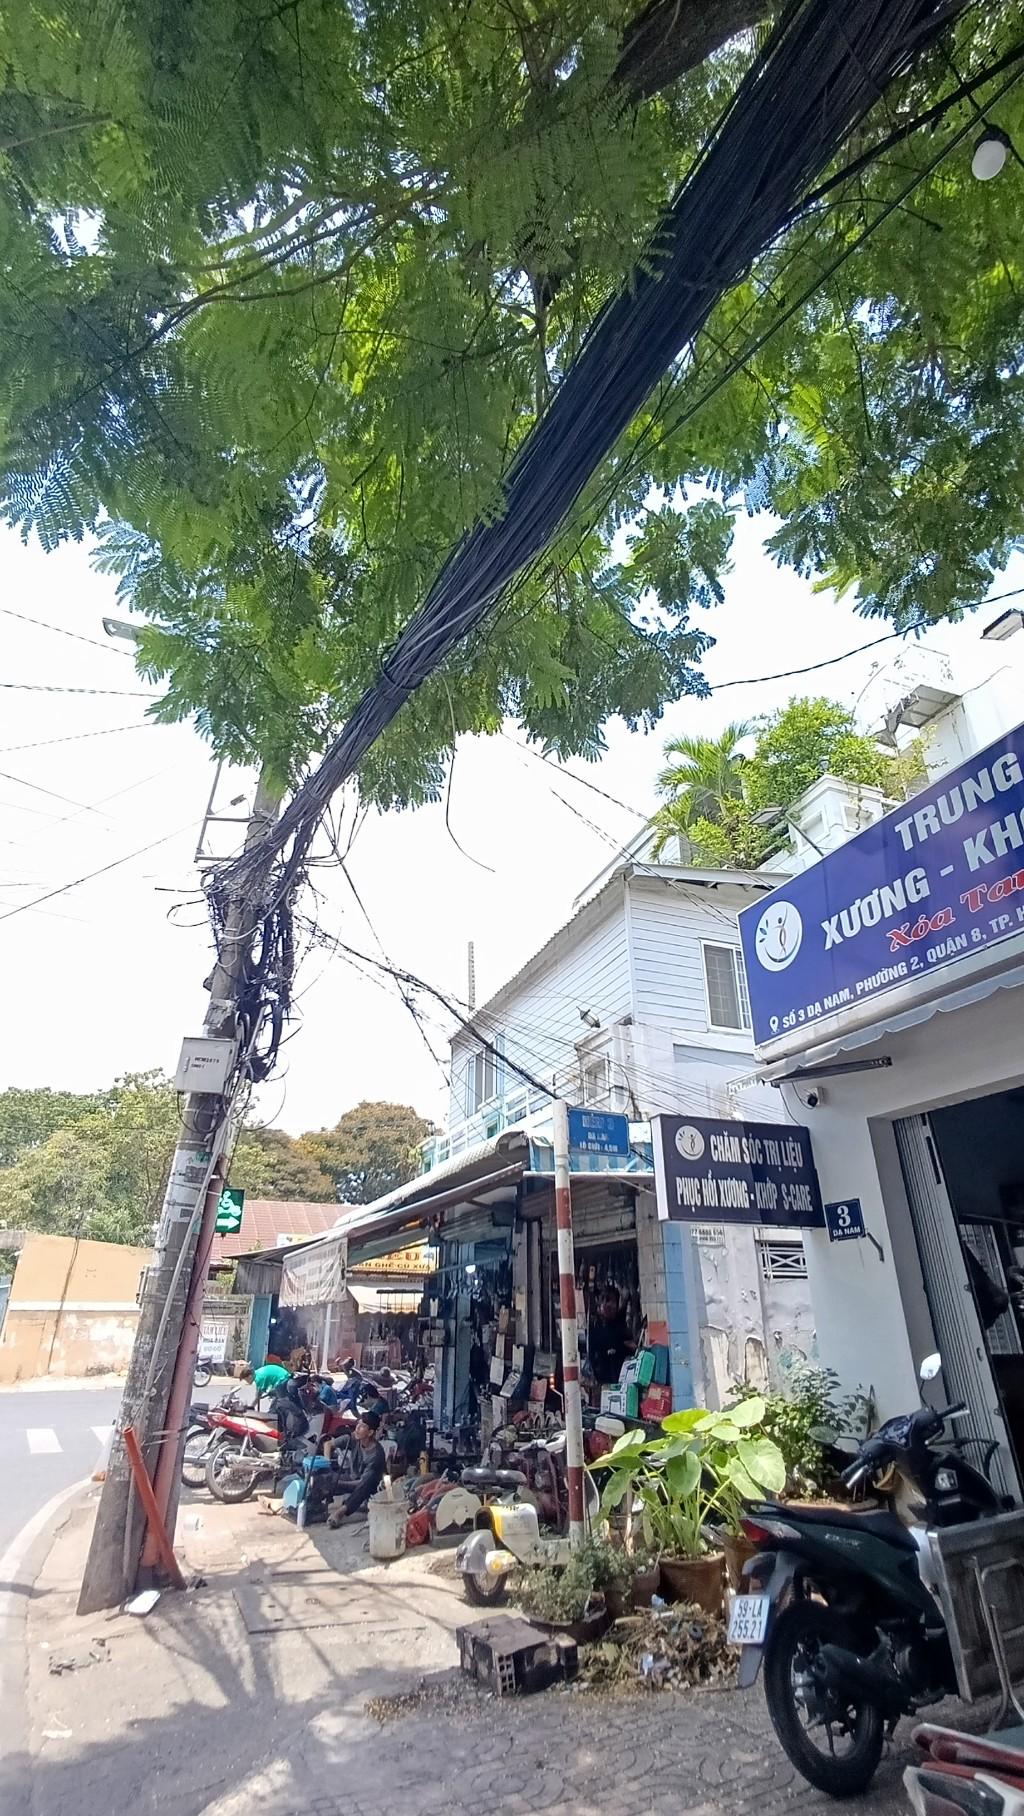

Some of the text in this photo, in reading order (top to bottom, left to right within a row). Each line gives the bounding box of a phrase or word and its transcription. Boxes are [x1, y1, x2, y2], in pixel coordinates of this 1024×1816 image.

[894, 752, 1024, 852] TRUNG
[820, 867, 931, 951] XƯƠNG
[963, 806, 1024, 872] KH
[886, 906, 957, 953] Xóa
[798, 1009, 806, 1021] 3
[823, 988, 855, 1010] NAM,
[855, 961, 908, 996] PHƯỜNG
[909, 956, 925, 971] 2,
[926, 933, 968, 963] QUẬN
[970, 927, 987, 943] 8,
[988, 914, 1013, 934] TP.
[709, 1130, 804, 1173] CHĂM SÓC TRỊ LIỆU
[675, 1176, 702, 1213] PHỤC
[754, 1177, 778, 1210] KHỚP
[780, 1183, 813, 1212] S-CARE
[837, 1205, 851, 1227] 3
[844, 1226, 861, 1235] NAM
[737, 1599, 763, 1618] 59-LA
[731, 1620, 762, 1640] 255.21
